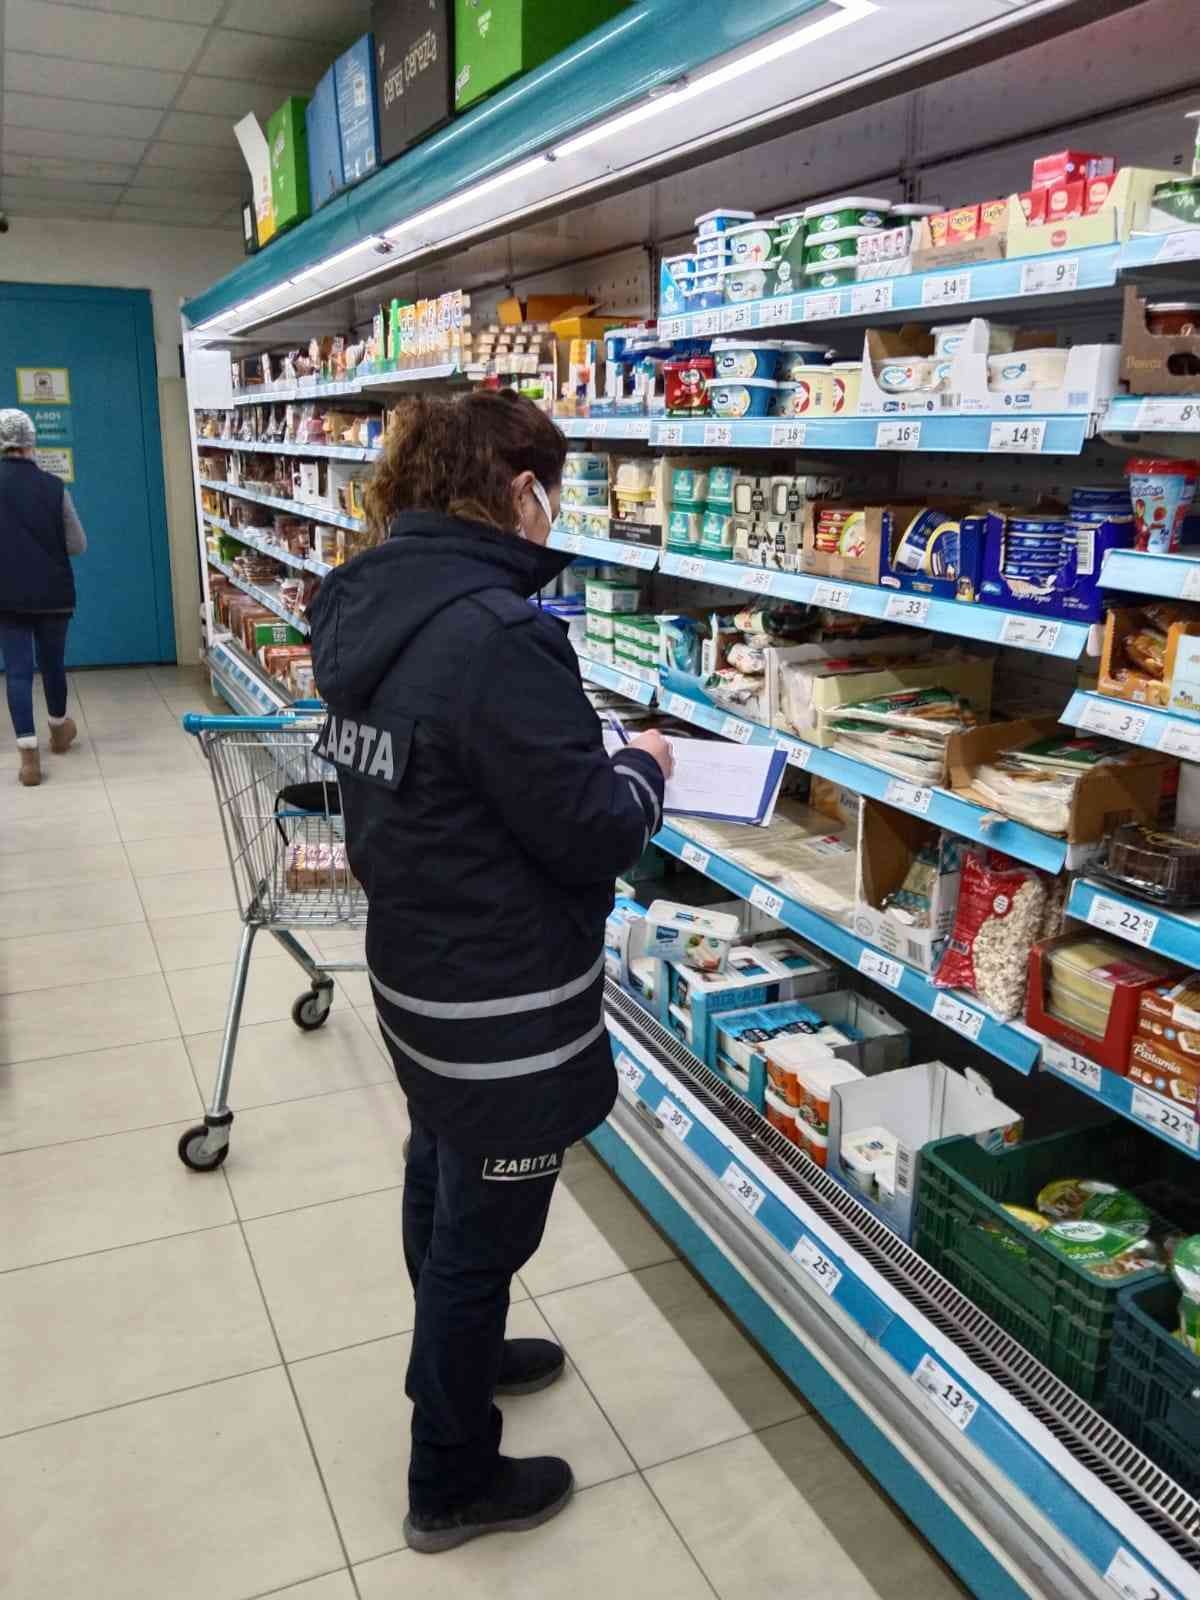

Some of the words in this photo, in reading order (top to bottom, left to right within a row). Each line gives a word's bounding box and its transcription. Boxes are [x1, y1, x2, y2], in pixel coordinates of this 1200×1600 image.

[1011, 427, 1029, 443] 14
[1036, 625, 1047, 639] 7
[1119, 715, 1132, 731] 3
[1120, 912, 1141, 931] 22
[957, 1010, 973, 1025] 17
[1070, 1056, 1088, 1076] 12
[1160, 1109, 1180, 1132] 22
[493, 1152, 557, 1173] ZABITA
[812, 1255, 830, 1275] 25
[942, 1384, 963, 1408] 13
